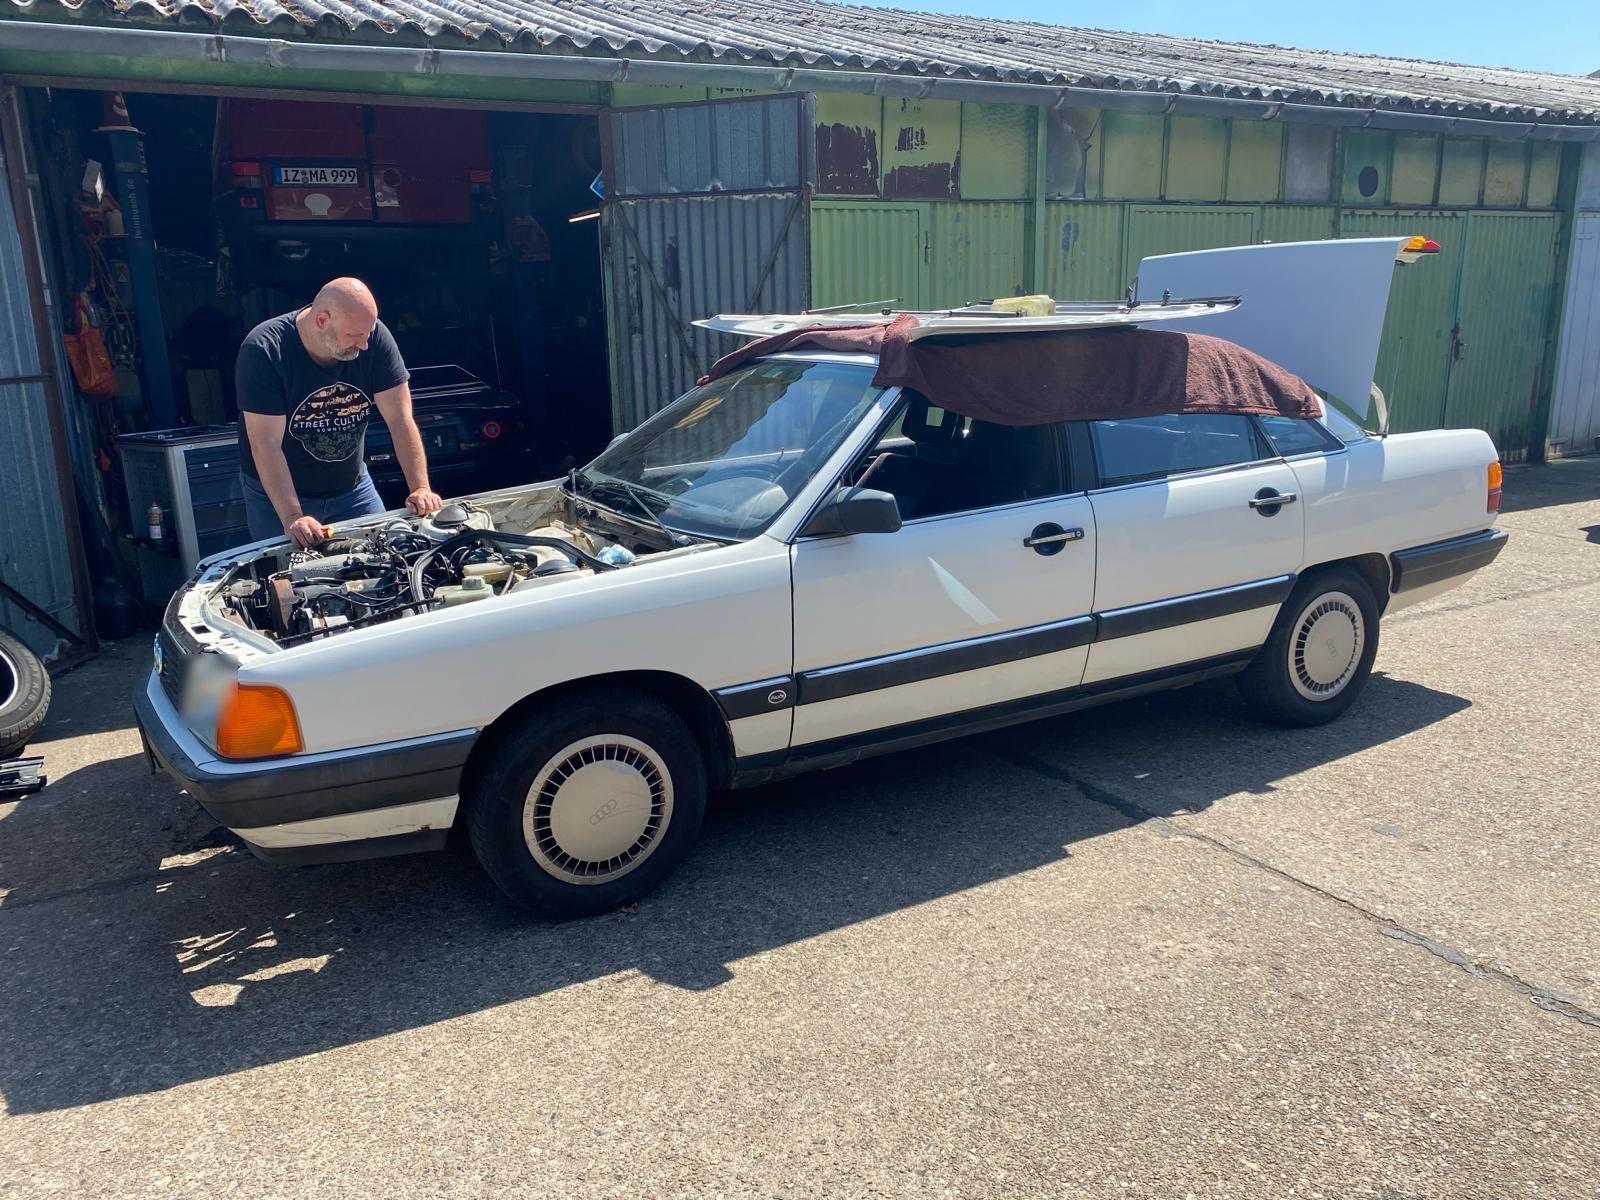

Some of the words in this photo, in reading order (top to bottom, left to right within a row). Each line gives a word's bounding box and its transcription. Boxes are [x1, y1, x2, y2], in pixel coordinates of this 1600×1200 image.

[283, 169, 300, 182] IZ
[309, 169, 328, 182] MA
[330, 169, 356, 182] 999
[293, 419, 330, 428] STREET
[333, 409, 370, 426] CULTURE
[316, 423, 356, 433] DOWNTOWN
